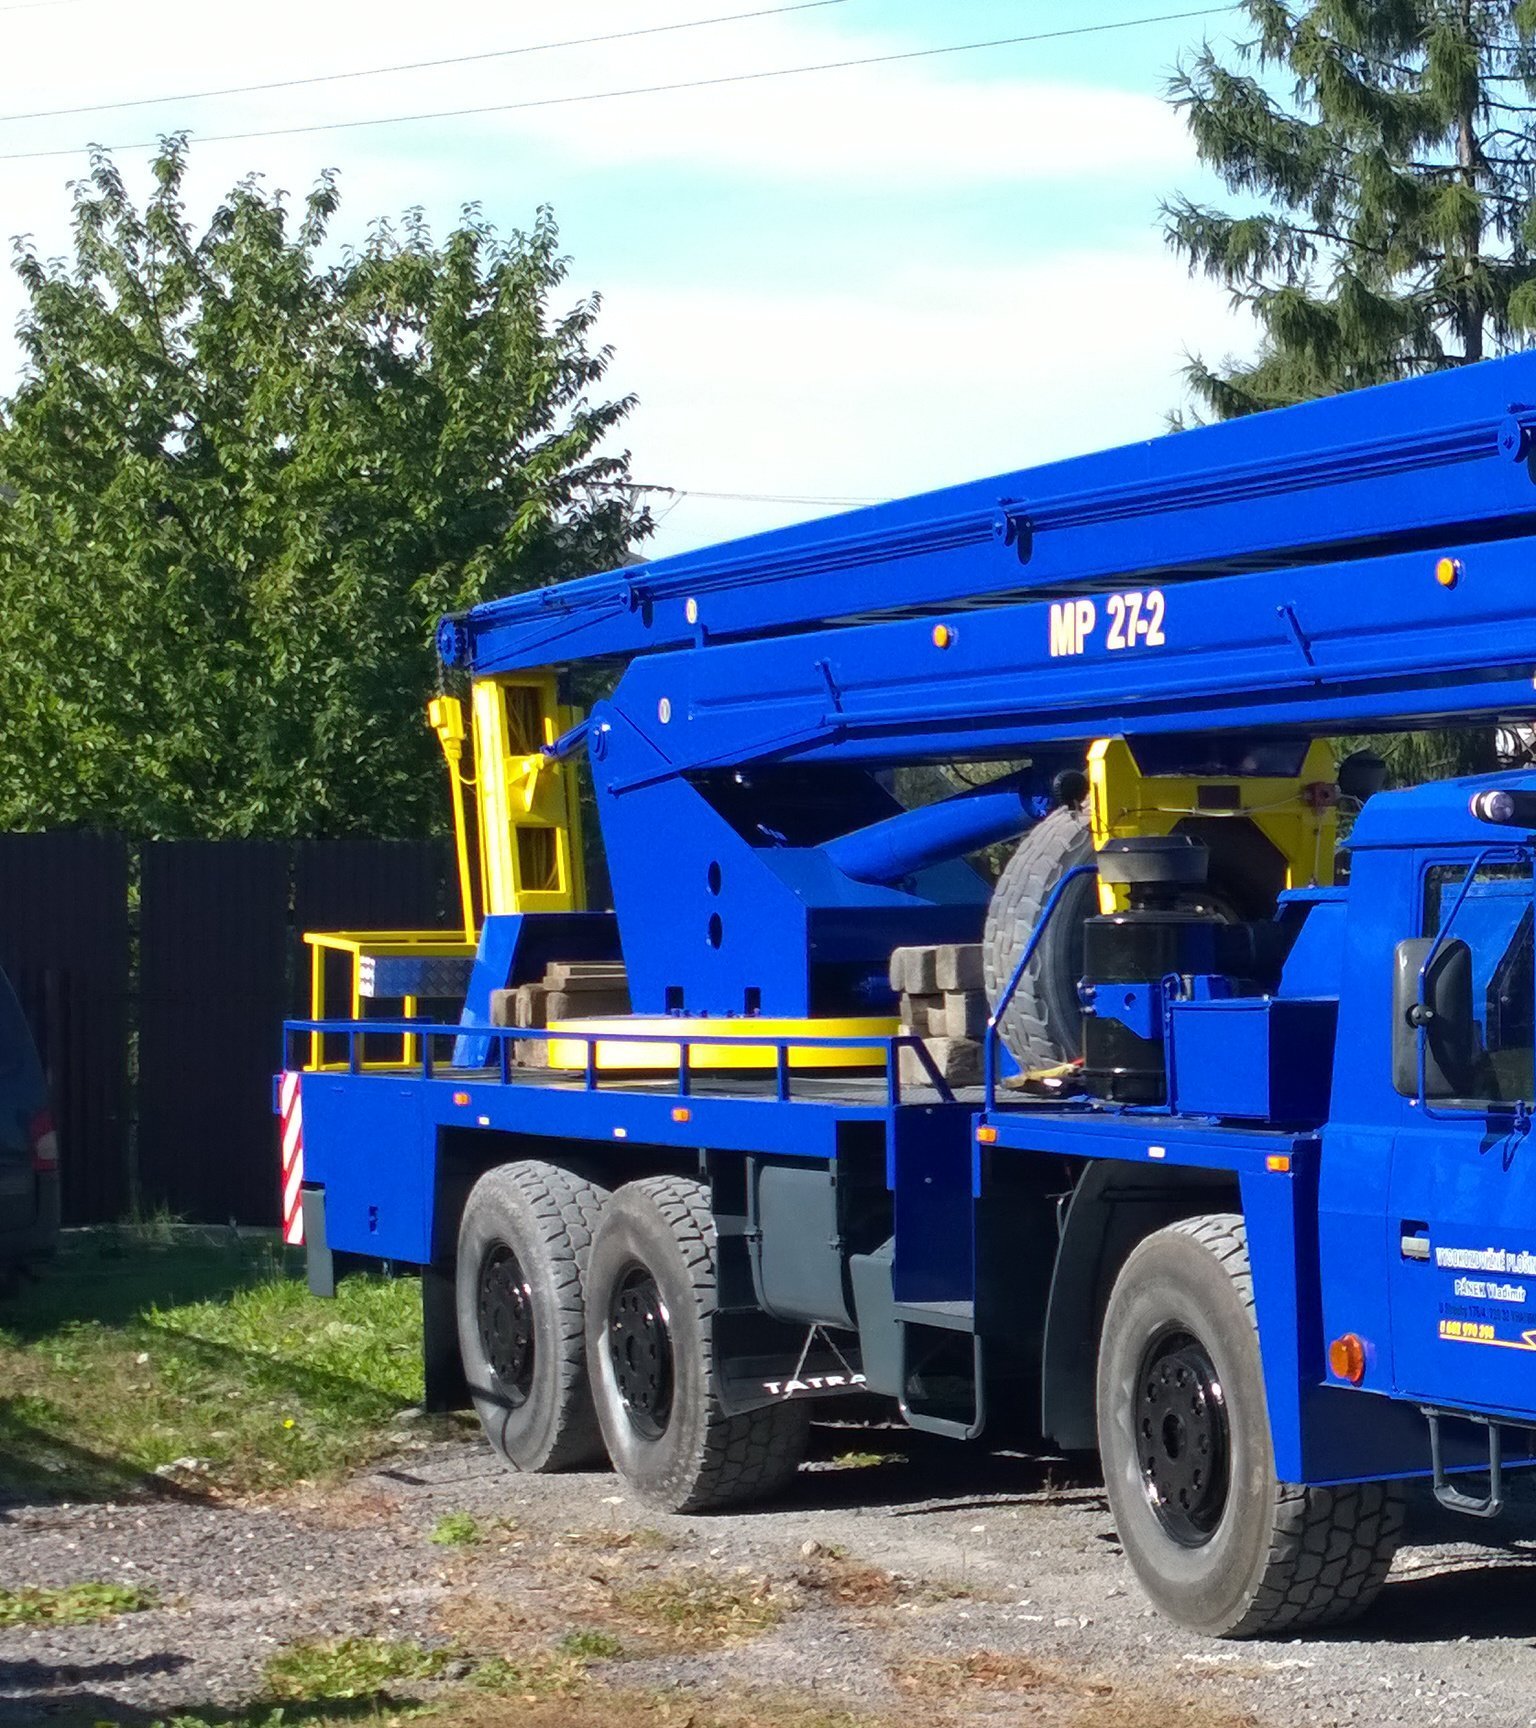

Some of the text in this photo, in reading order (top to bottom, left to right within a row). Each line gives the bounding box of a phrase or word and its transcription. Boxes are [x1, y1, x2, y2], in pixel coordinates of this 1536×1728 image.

[1050, 590, 1165, 657] MP 27-2
[1454, 1277, 1527, 1303] PÁNEK Vladimír
[763, 1374, 866, 1394] TATRA
